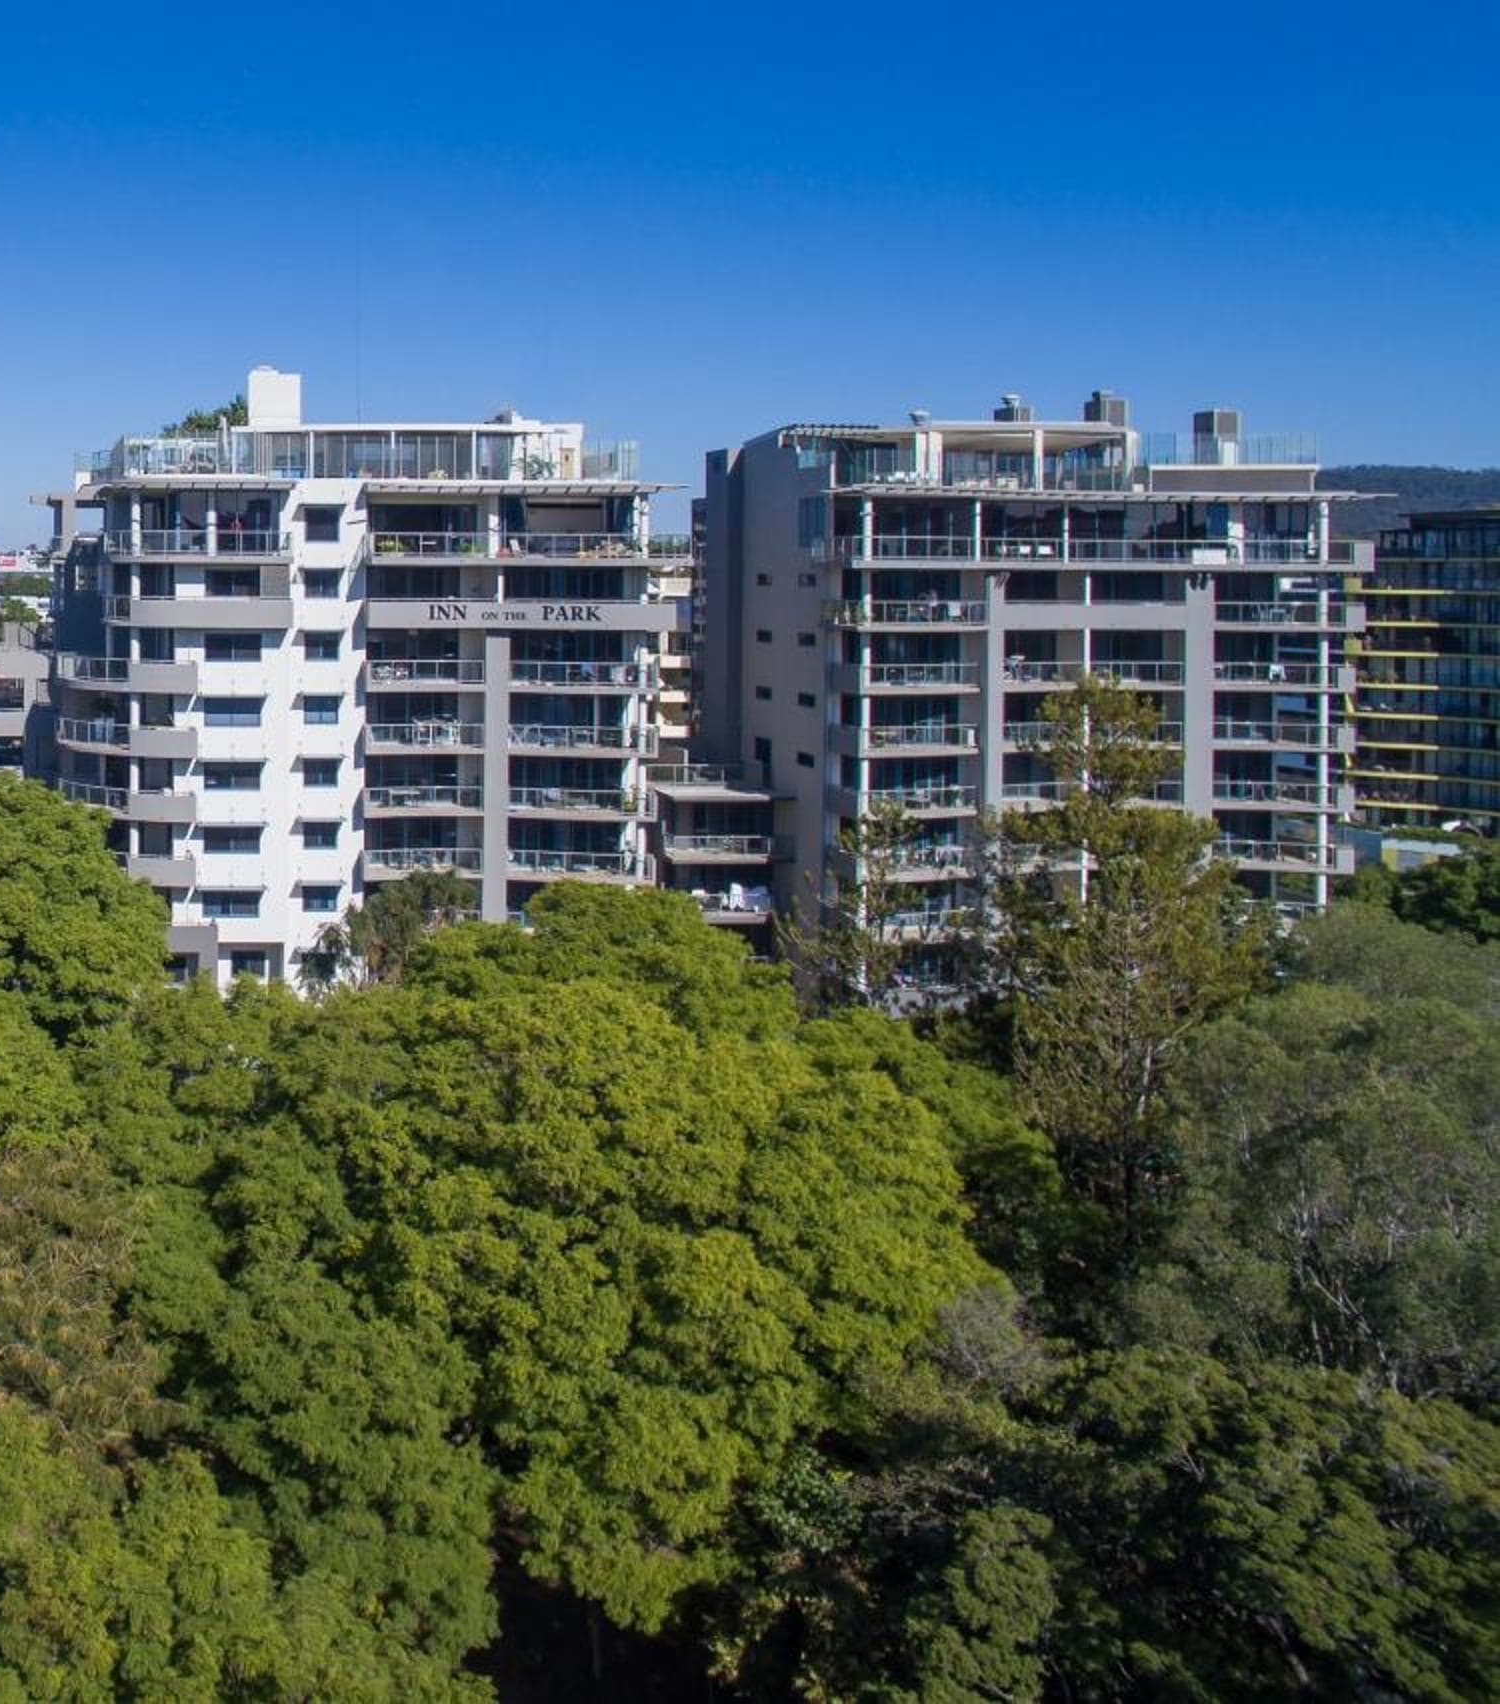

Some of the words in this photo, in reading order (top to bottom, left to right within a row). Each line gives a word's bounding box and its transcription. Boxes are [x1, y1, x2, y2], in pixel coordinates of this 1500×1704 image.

[429, 605, 467, 621] INN
[481, 611, 499, 621] ON
[503, 611, 527, 621] THE
[542, 605, 602, 621] PARK
